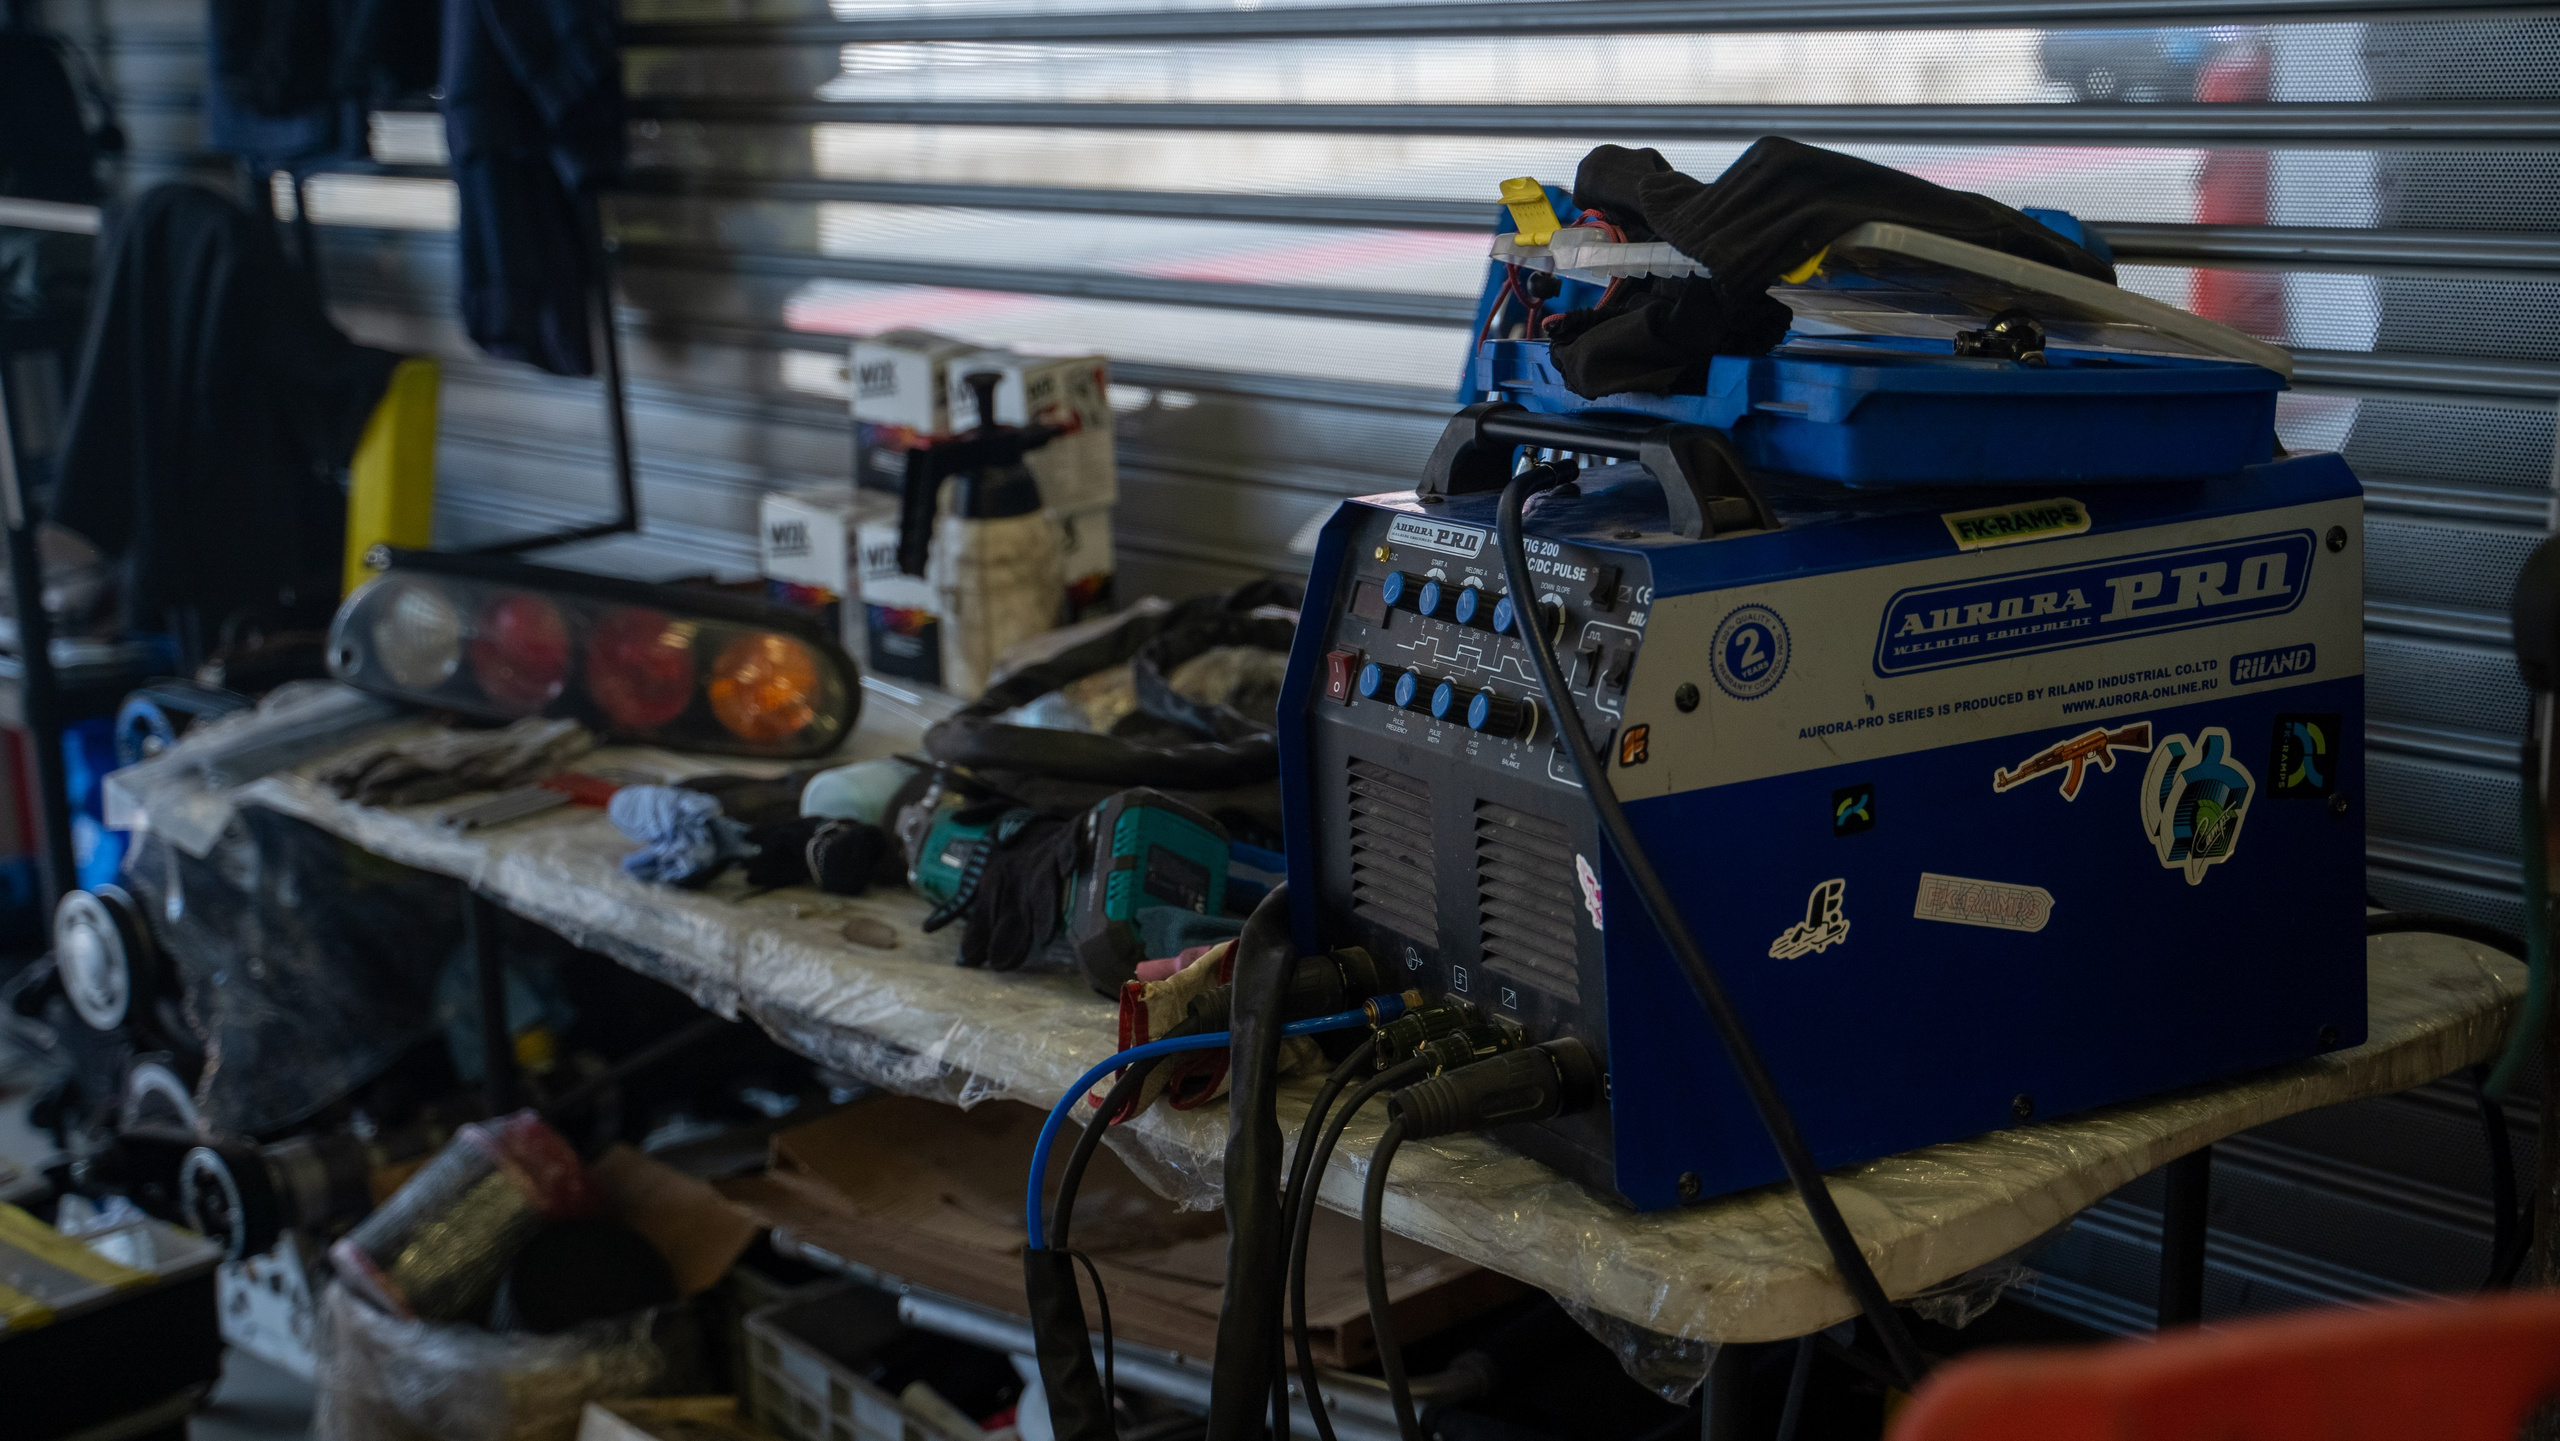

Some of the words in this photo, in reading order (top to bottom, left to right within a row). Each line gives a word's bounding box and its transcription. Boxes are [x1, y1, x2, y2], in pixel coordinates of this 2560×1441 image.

[1956, 505, 2080, 539] FK-RAMPS
[1393, 522, 1434, 538] AURORA
[1433, 528, 1479, 552] PRO
[1522, 539, 1539, 553] TIG
[1540, 542, 1560, 557] 200
[1430, 558, 1443, 567] START
[1464, 566, 1483, 576] WELDING
[1525, 556, 1551, 574] C/DC
[1552, 562, 1588, 581] PULSE
[1555, 585, 1571, 595] SLOPE
[1893, 587, 2092, 638] AURORA
[2099, 551, 2293, 624] PRO
[1735, 613, 1771, 635] QUALITY
[1892, 634, 1981, 656] WELDING
[1985, 616, 2092, 641] EQUIPMENT
[1735, 628, 1766, 669] 2
[1718, 661, 1753, 692] WARRANTY
[1754, 658, 1783, 690] CONTROL
[1775, 633, 1784, 656] PASS
[1740, 660, 1770, 679] YEARS
[2235, 649, 2311, 681] RILAND
[1798, 715, 1884, 740] AURORA-PRO
[1888, 706, 1934, 725] SERIES
[1937, 701, 1950, 715] IS
[1954, 691, 2024, 714] PRODUCED
[2027, 688, 2044, 701] BY
[2047, 680, 2094, 698] RILAND
[2097, 667, 2171, 690] INDUSTRIAL
[2174, 659, 2218, 677] CO.LTD
[2061, 678, 2219, 715] WWW.AURORA-ONLINE.RU
[1385, 723, 1408, 735] FREQUENCY
[1392, 717, 1405, 726] PULSE
[1428, 728, 1442, 738] PULSE
[1467, 739, 1479, 749] POST
[2278, 721, 2292, 789] FK-RAMPS
[1501, 757, 1521, 769] BALANCE
